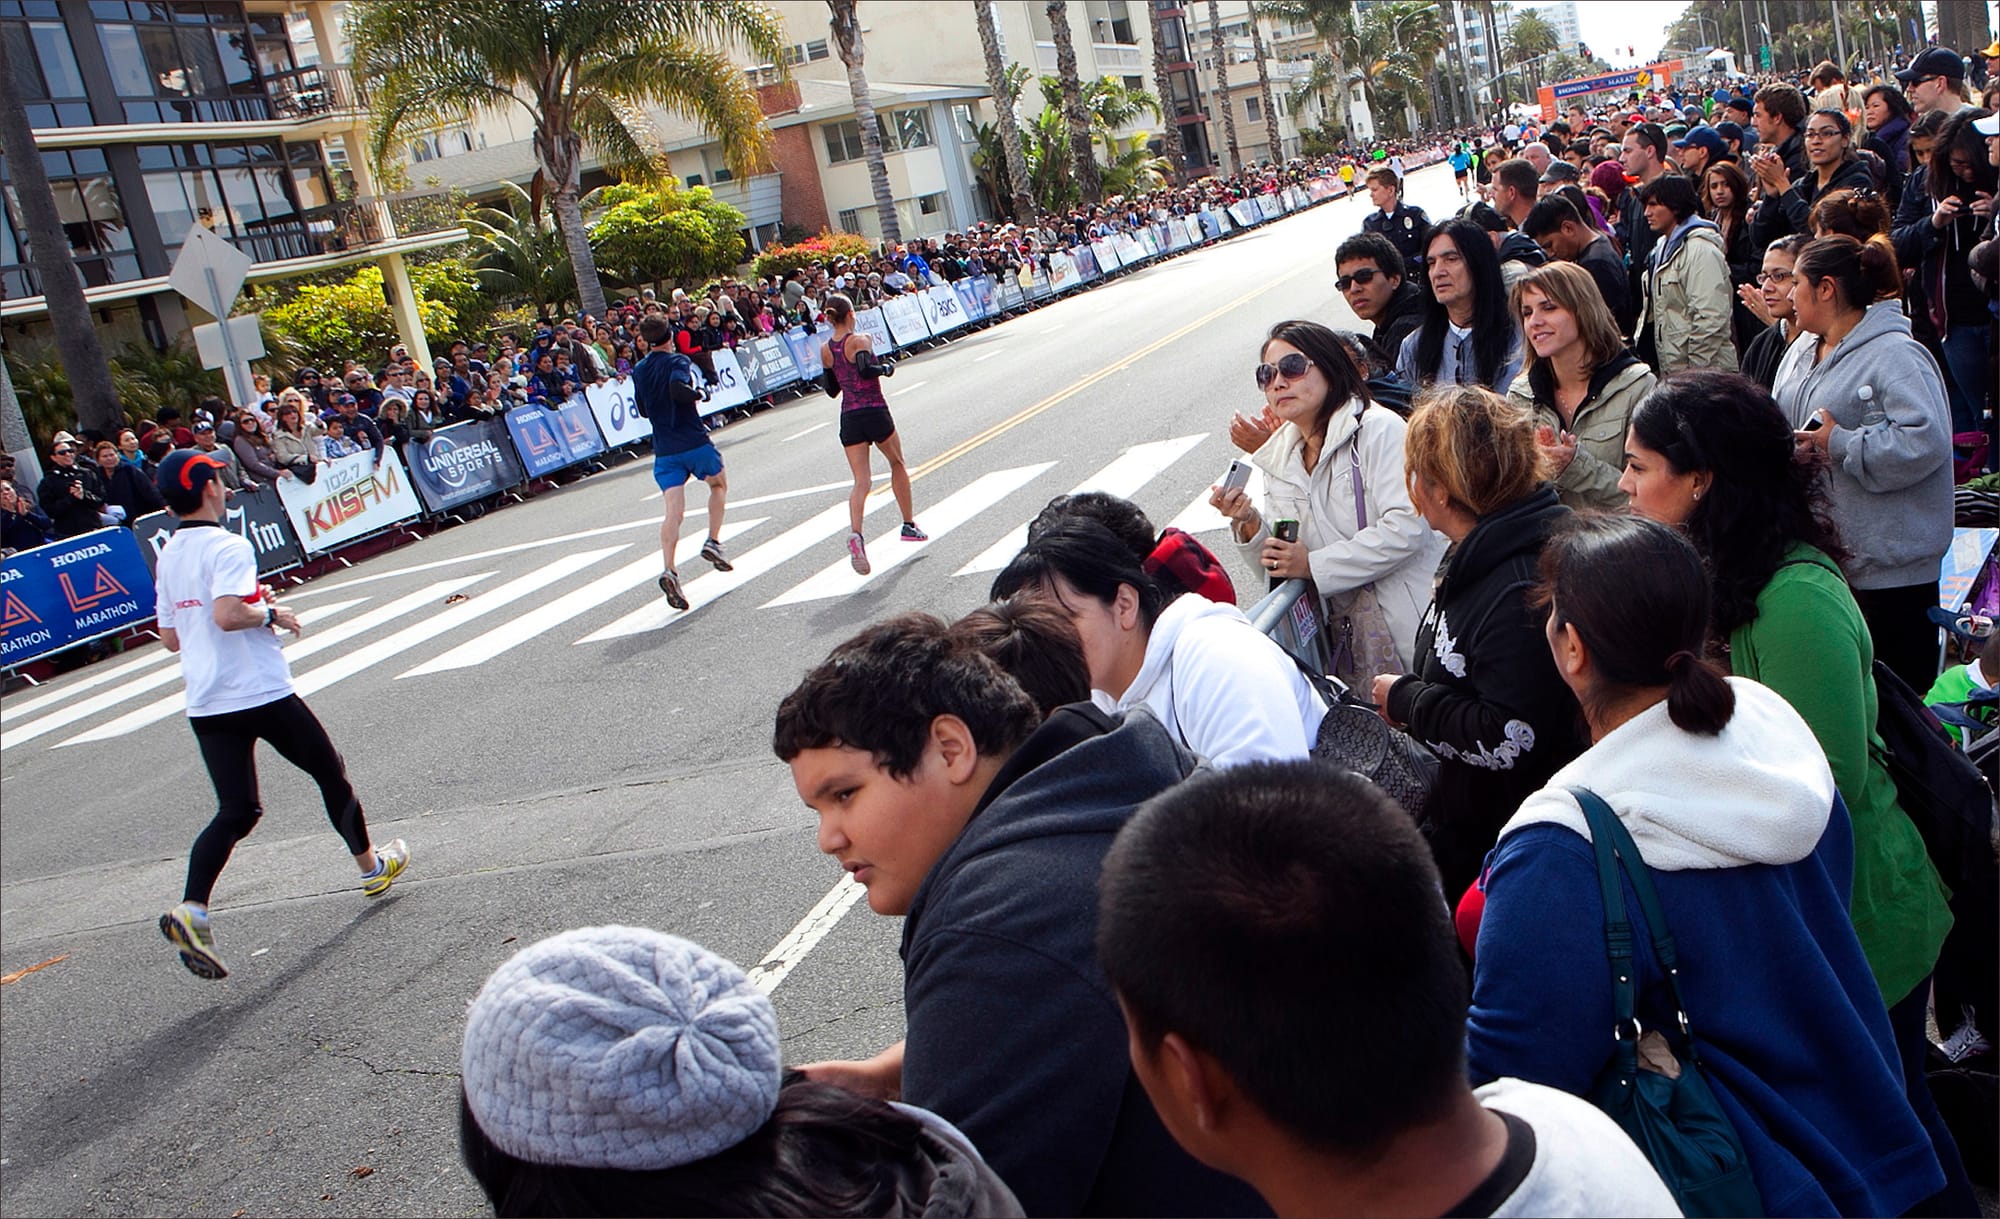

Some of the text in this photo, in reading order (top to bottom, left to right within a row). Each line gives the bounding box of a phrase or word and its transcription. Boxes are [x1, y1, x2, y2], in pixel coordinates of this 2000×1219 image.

[1558, 83, 1590, 95] HONDA
[515, 409, 545, 425] HONDA
[558, 411, 591, 443] LA
[521, 423, 559, 456] LA
[424, 439, 499, 473] UNIVERSAL
[448, 452, 503, 478] SPORTS
[534, 450, 566, 468] MARATHON
[325, 463, 361, 492] 102.7
[50, 543, 112, 568] HONDA
[58, 562, 130, 613] LA
[74, 600, 139, 630] MARATHON
